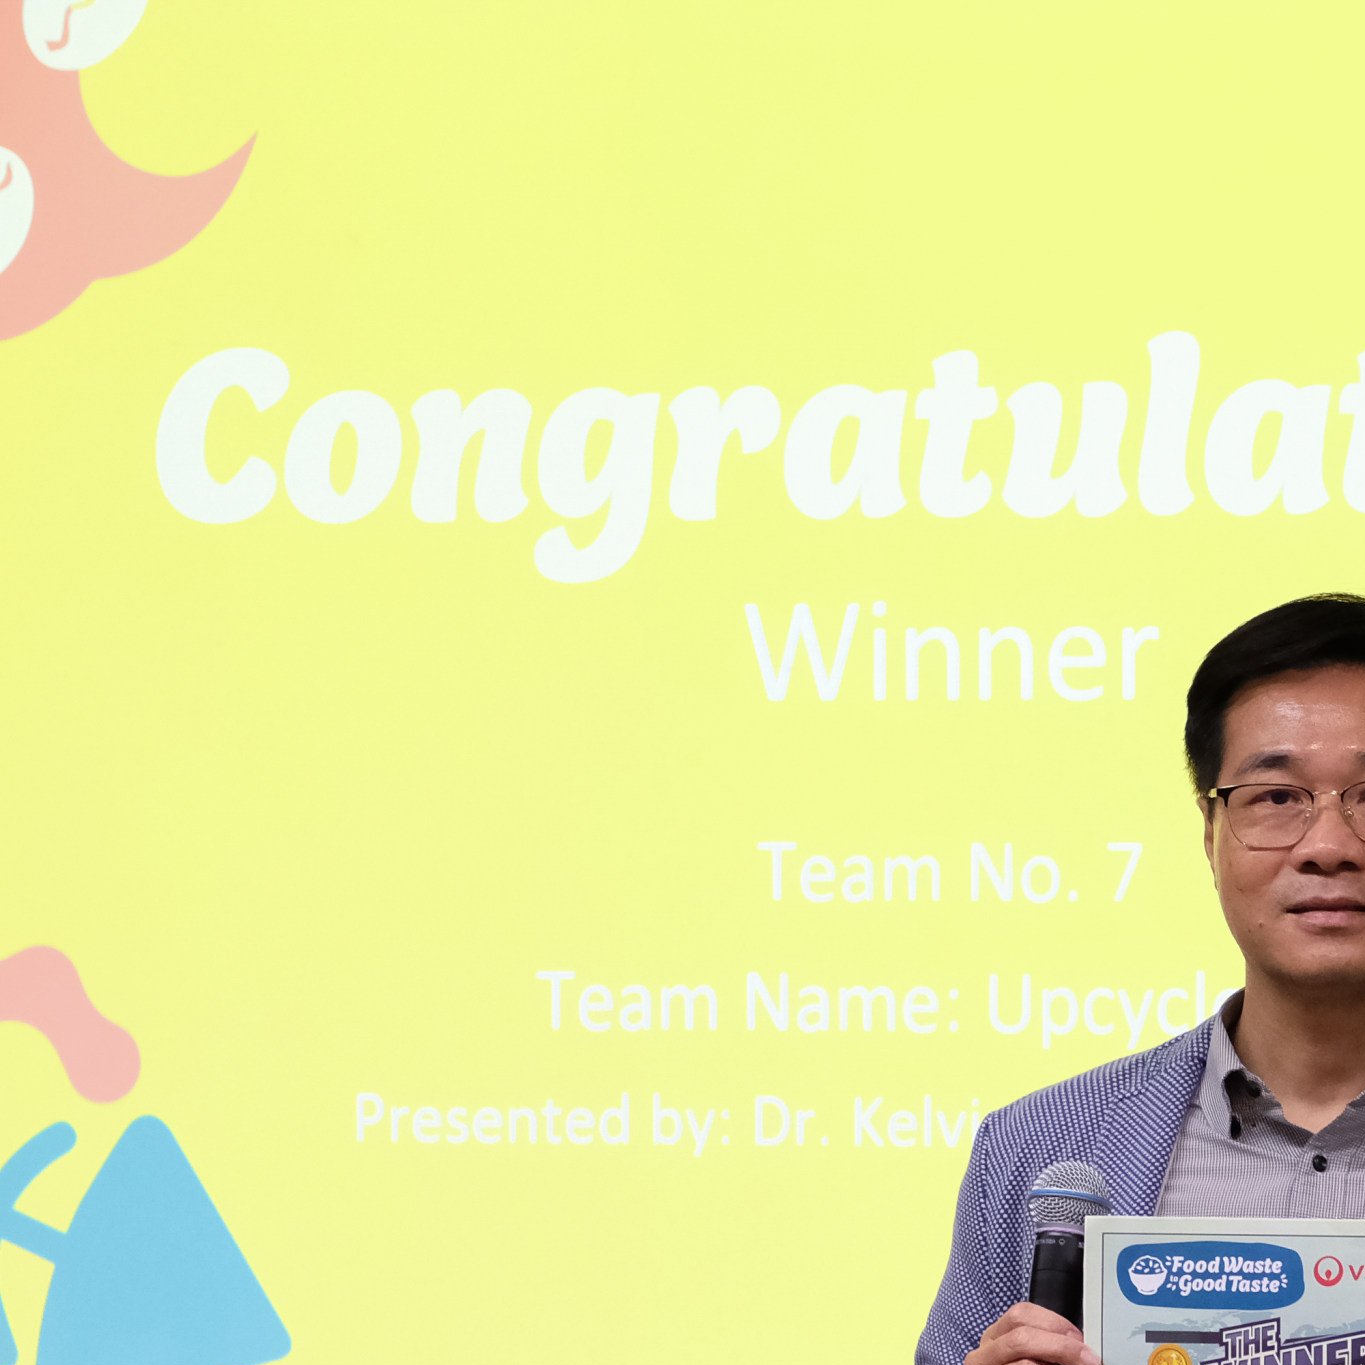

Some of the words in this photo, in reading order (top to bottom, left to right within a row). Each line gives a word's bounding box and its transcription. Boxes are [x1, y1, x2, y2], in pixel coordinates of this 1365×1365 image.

[743, 600, 1160, 703] Winner
[756, 840, 941, 903] Team
[969, 841, 1079, 904] No.
[1106, 841, 1144, 903] 7
[535, 970, 718, 1031] Team
[745, 971, 959, 1034] Name:
[355, 1091, 631, 1146] Presented
[651, 1091, 731, 1159] by:
[754, 1094, 830, 1147] Dr.
[1171, 1255, 1224, 1274] Food
[1223, 1255, 1283, 1274] Waste
[1178, 1275, 1227, 1297] Good
[1229, 1275, 1281, 1293] Taste
[1222, 1320, 1278, 1360] THE
